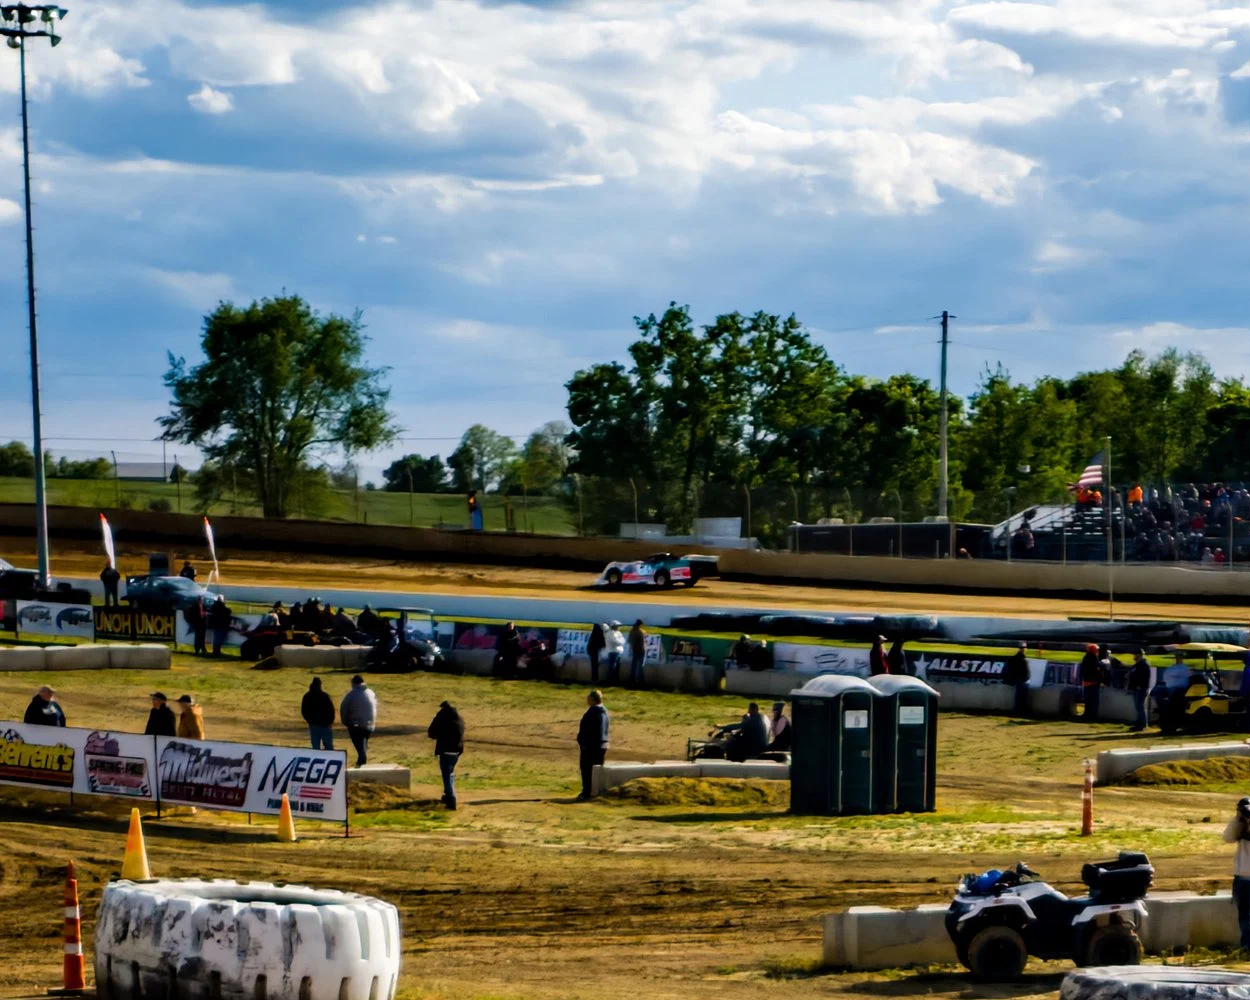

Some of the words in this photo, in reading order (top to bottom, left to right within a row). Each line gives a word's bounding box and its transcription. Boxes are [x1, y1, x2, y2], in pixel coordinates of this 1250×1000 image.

[96, 612, 131, 632] UNOH
[136, 613, 174, 634] UNOH
[928, 658, 1005, 674] ALLSTAR
[160, 746, 253, 788] Midwest
[257, 756, 343, 794] MEGA
